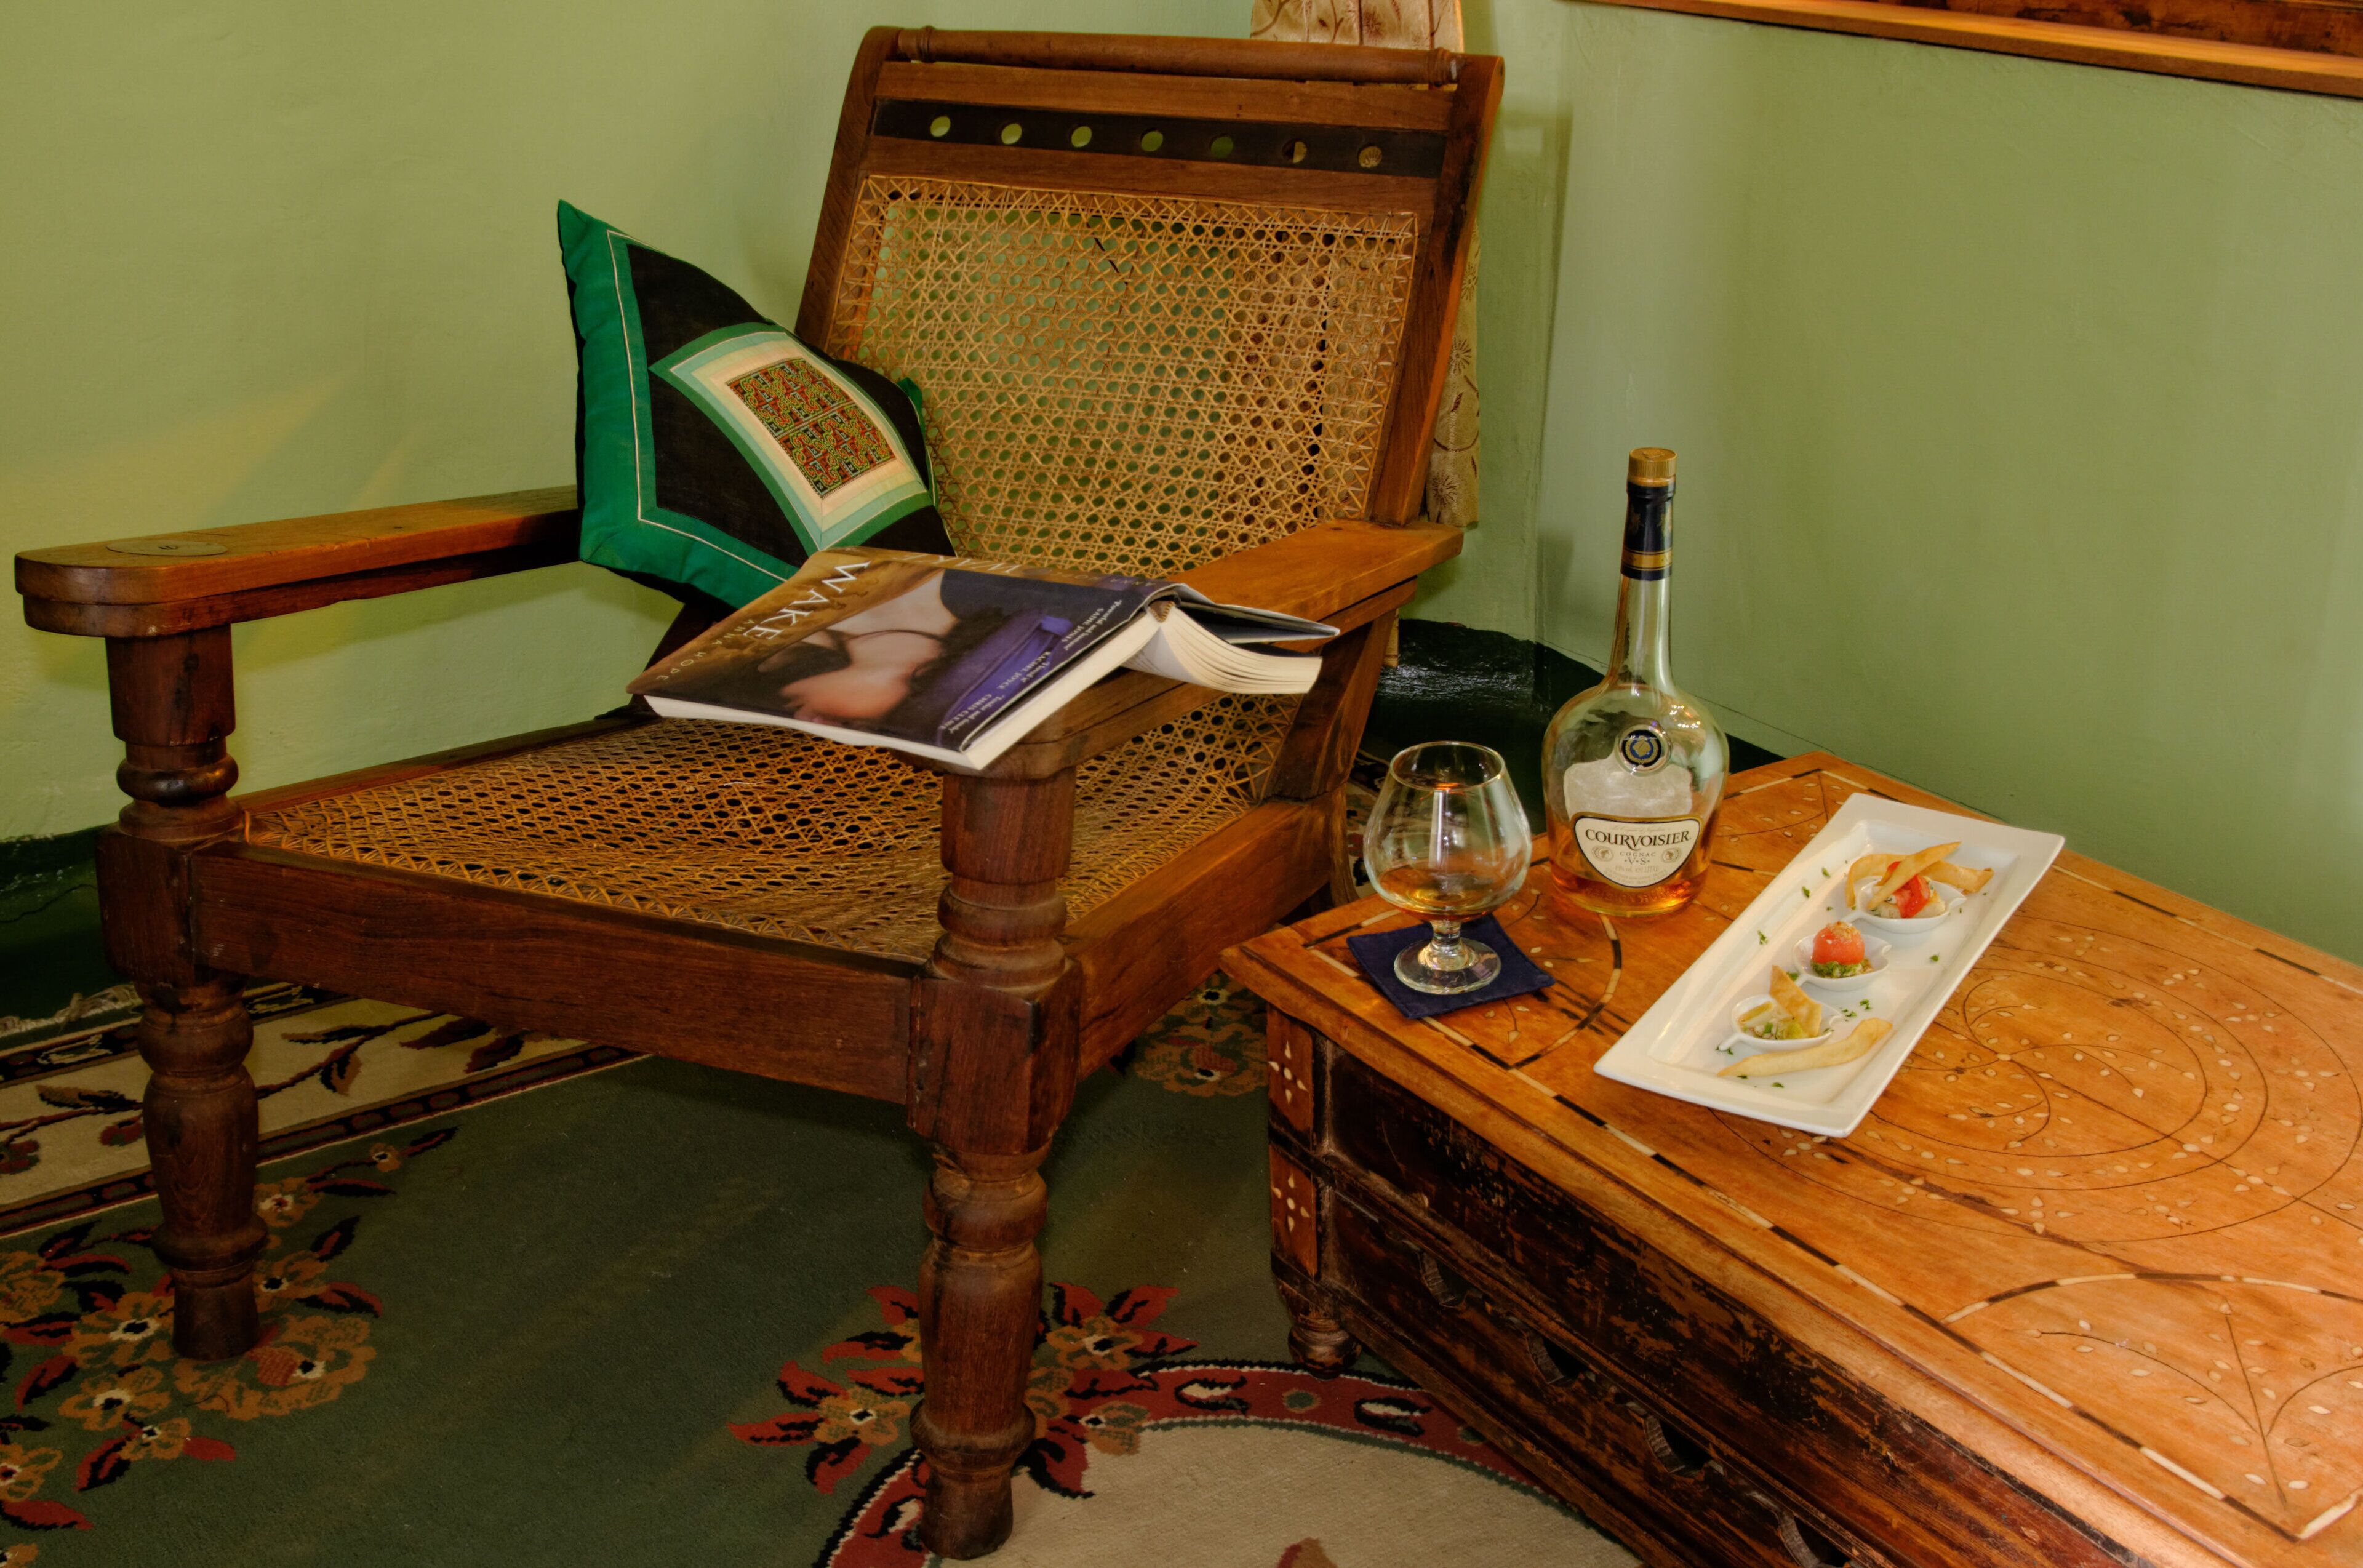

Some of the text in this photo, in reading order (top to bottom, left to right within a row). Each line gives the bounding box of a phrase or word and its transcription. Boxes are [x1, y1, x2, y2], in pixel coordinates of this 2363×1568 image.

[742, 561, 871, 641] WAKE
[1061, 607, 1105, 642] SADIE JONES
[656, 618, 756, 681] ANNA HOPE
[996, 651, 1051, 689] RACHEL JOYCE
[967, 694, 993, 710] CHRIS
[1585, 828, 1690, 851] COURVOISIER
